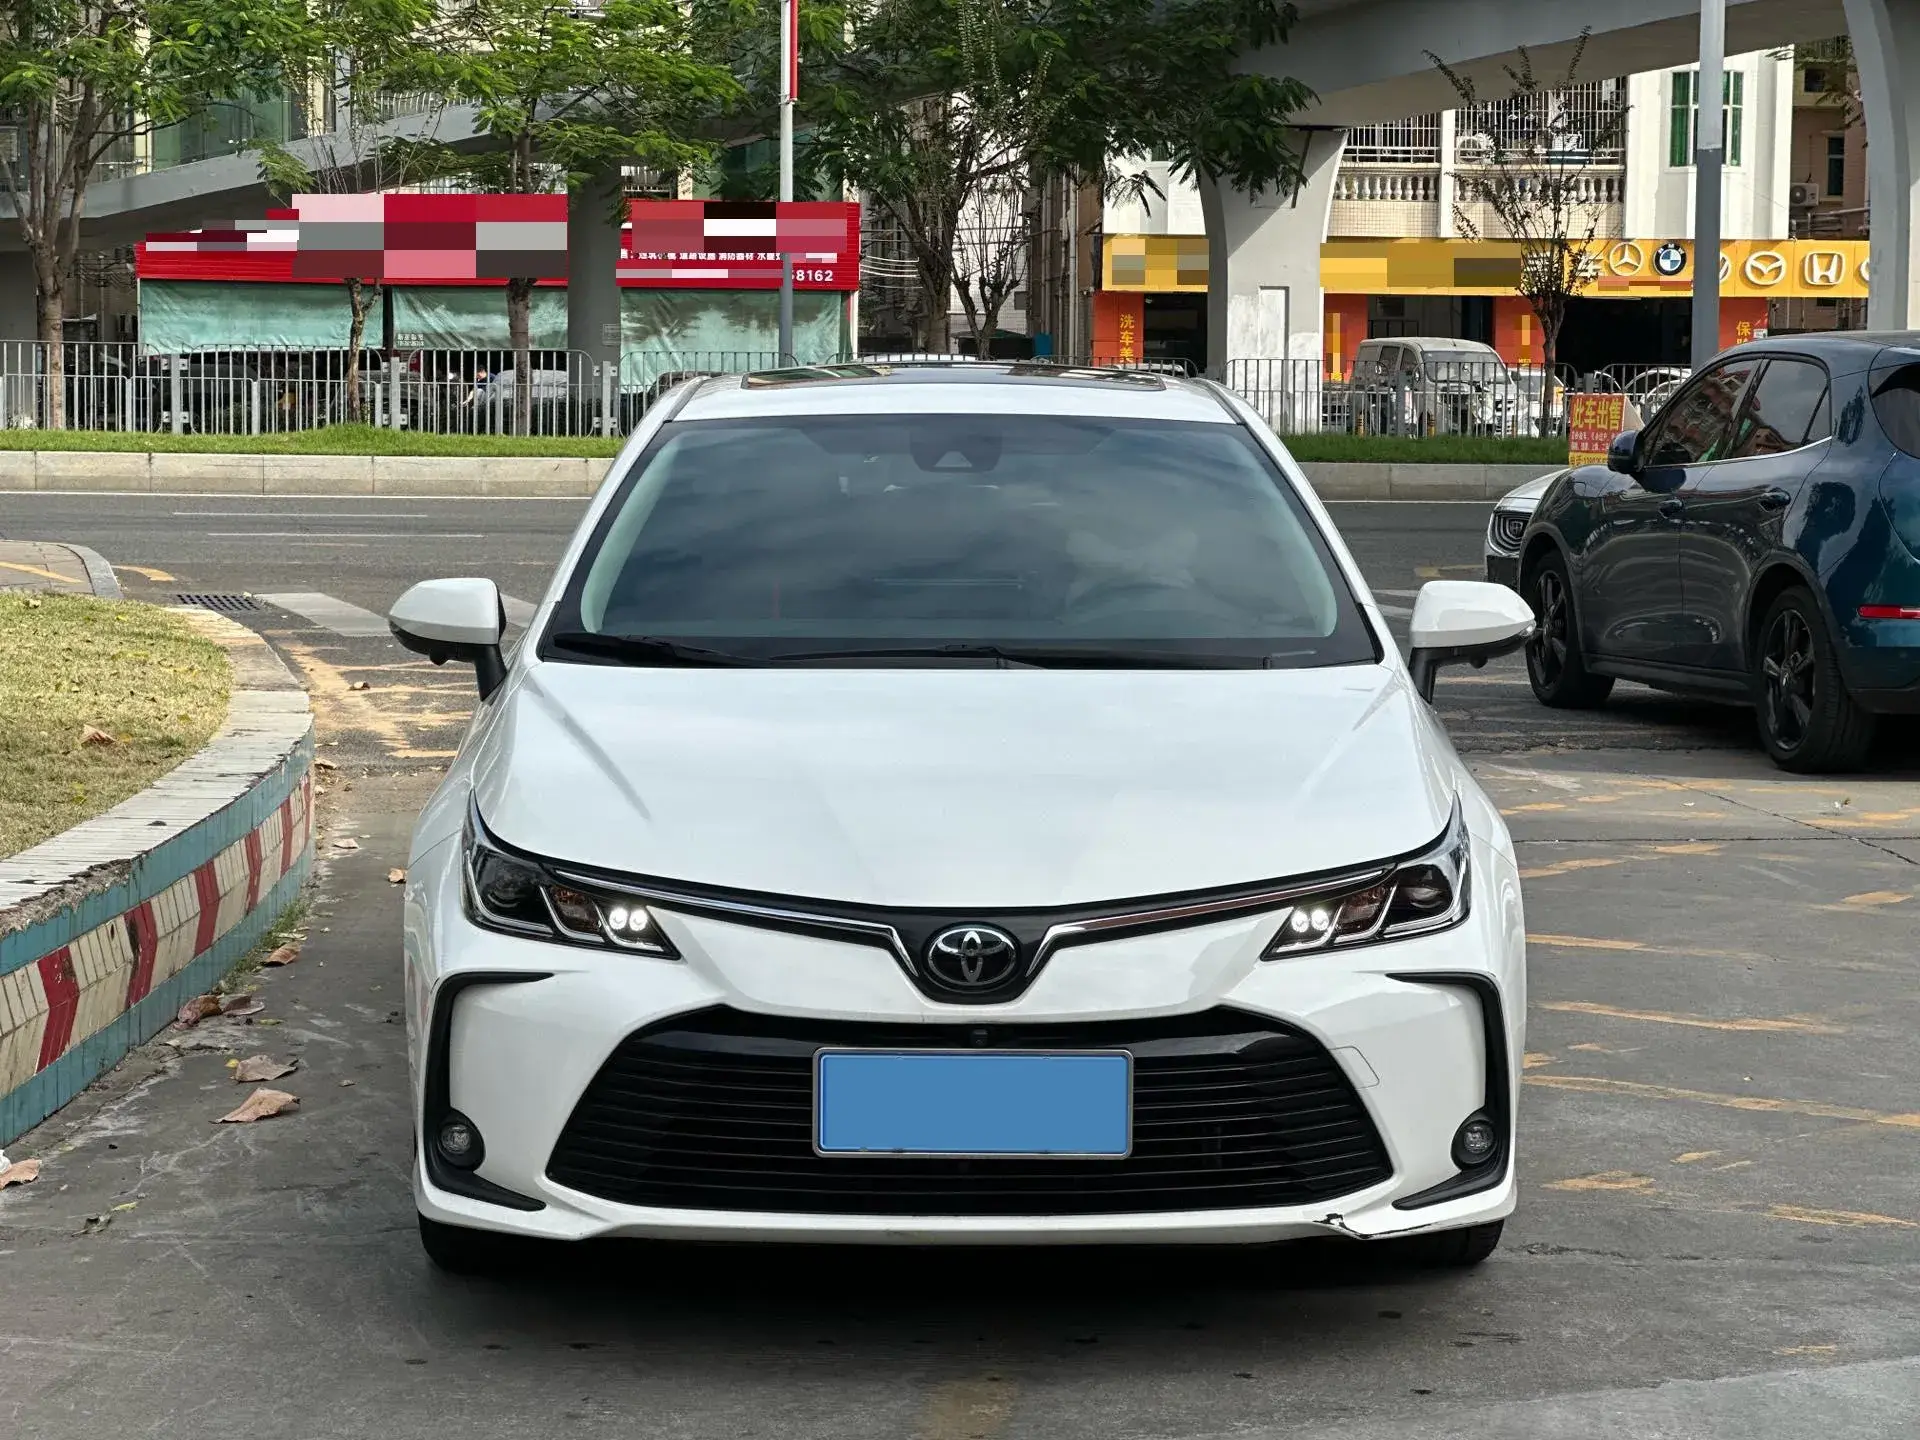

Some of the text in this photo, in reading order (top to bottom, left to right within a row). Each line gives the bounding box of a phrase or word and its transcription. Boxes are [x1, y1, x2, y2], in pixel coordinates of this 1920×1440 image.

[791, 269, 834, 282] 8162
[1571, 397, 1621, 430] 此车出售
